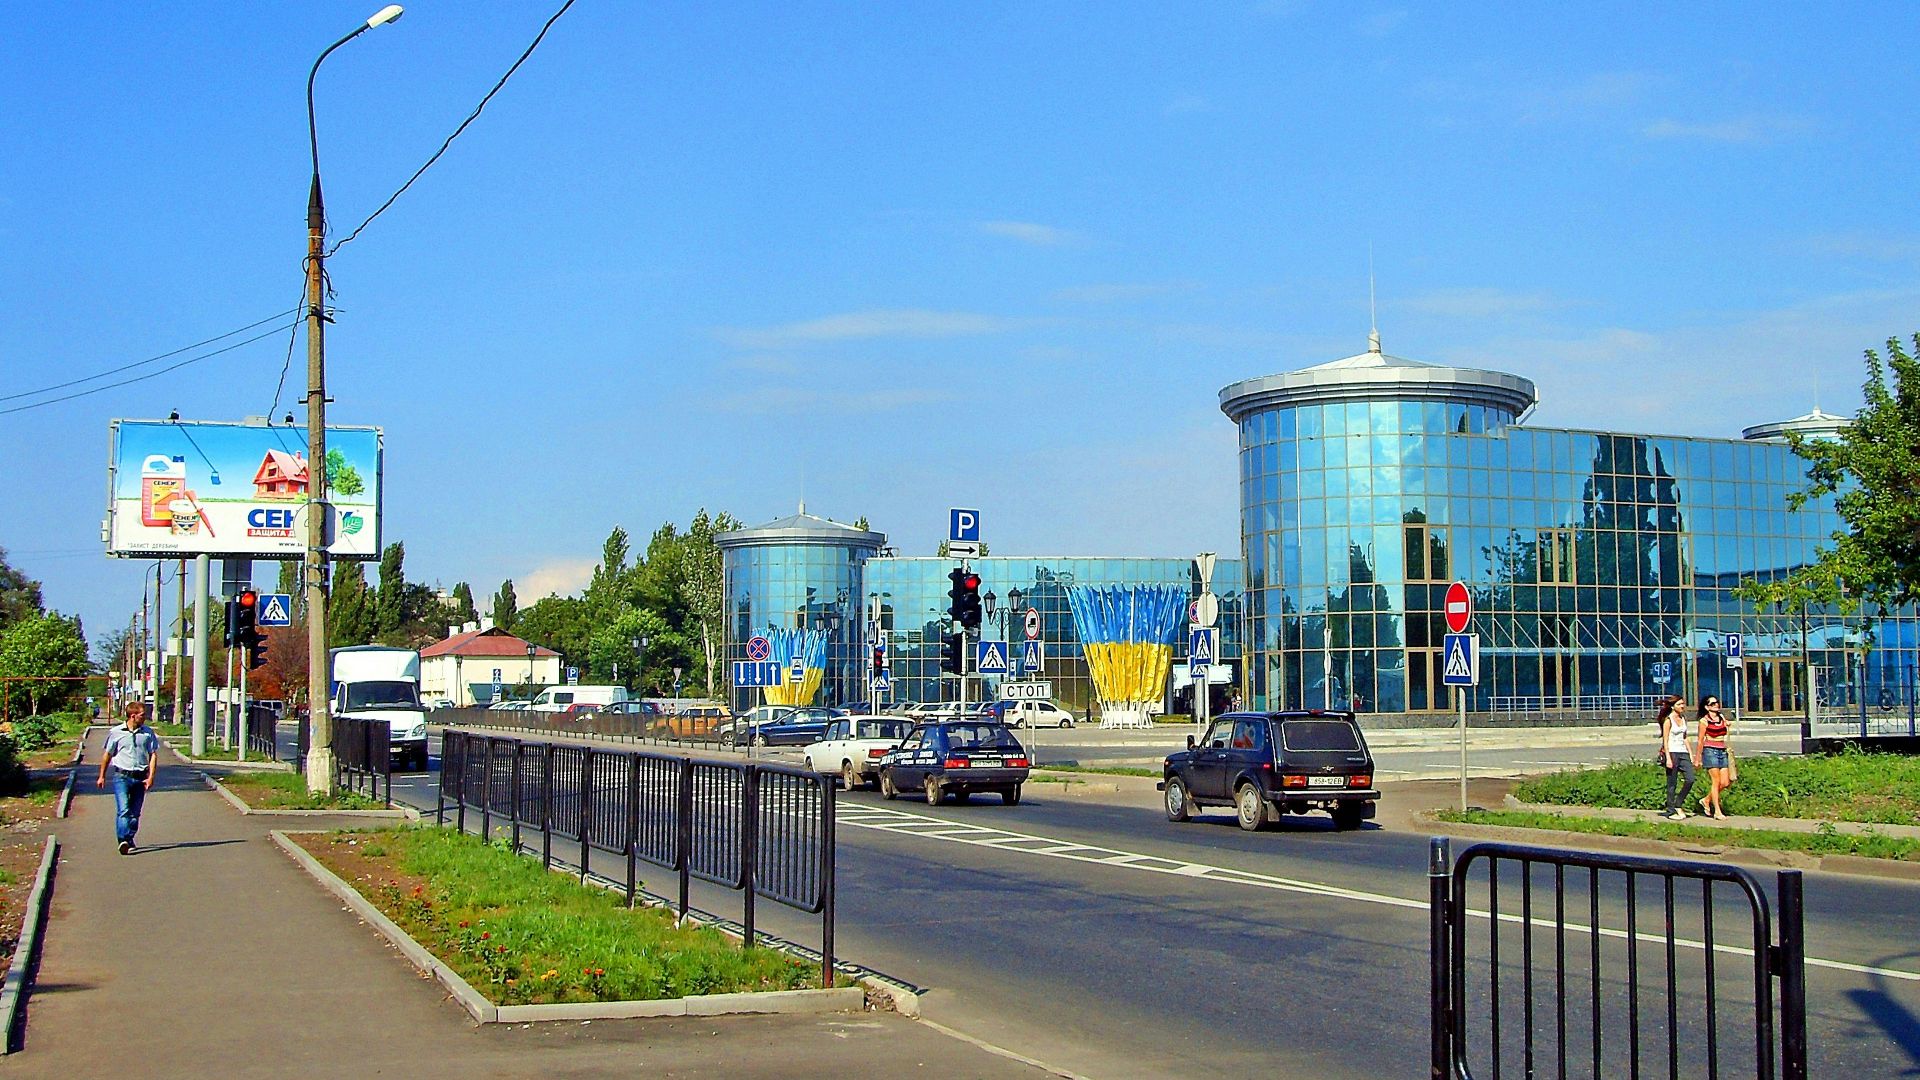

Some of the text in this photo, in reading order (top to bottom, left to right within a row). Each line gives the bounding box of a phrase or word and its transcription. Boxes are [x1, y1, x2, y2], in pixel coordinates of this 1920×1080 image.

[957, 511, 975, 538] P
[250, 529, 287, 537] ЗАЩИТА
[1729, 635, 1738, 656] P
[569, 668, 577, 677] P
[1006, 685, 1045, 698] СТОП
